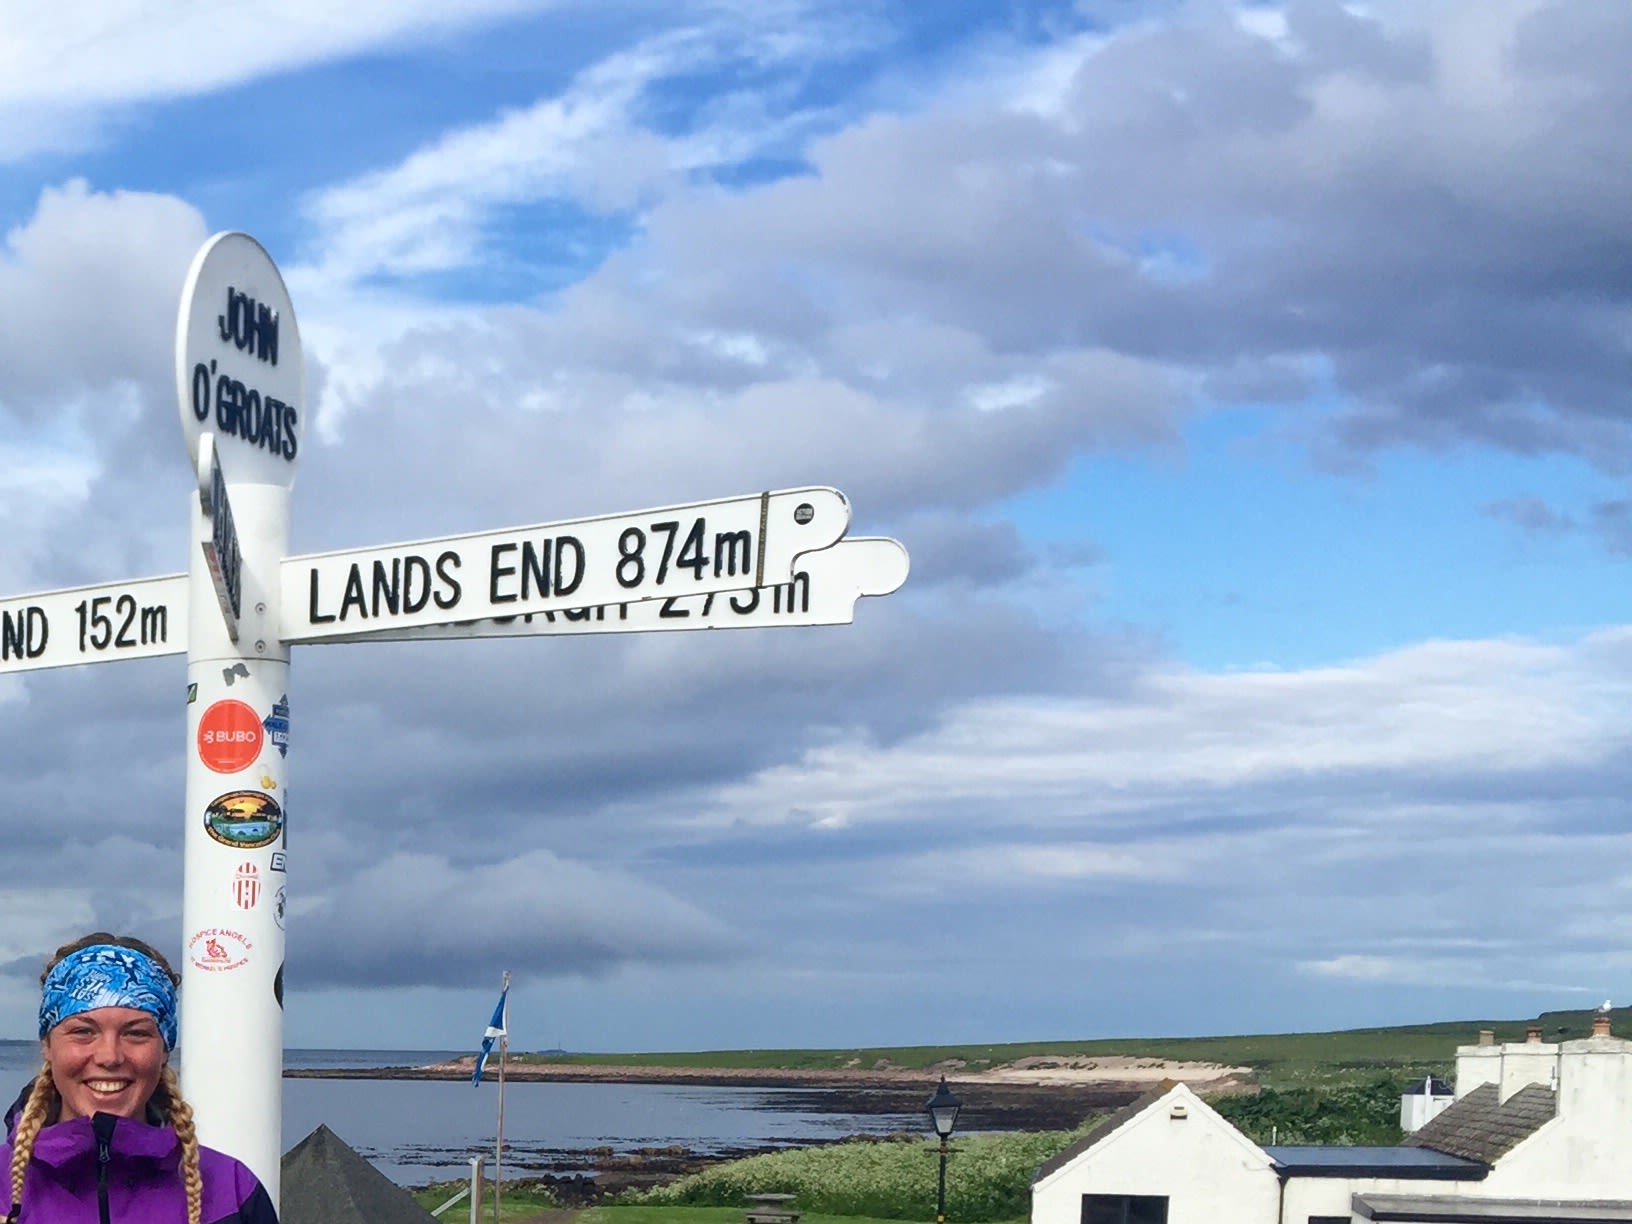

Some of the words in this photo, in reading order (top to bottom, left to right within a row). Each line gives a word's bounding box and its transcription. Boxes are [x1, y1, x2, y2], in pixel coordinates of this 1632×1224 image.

[218, 286, 279, 366] JOHN
[192, 359, 297, 462] O'GROATS
[309, 551, 461, 624] LANDS
[490, 536, 586, 604] END
[615, 517, 751, 588] 874m
[75, 594, 167, 652] 152m
[216, 731, 256, 743] BUBO
